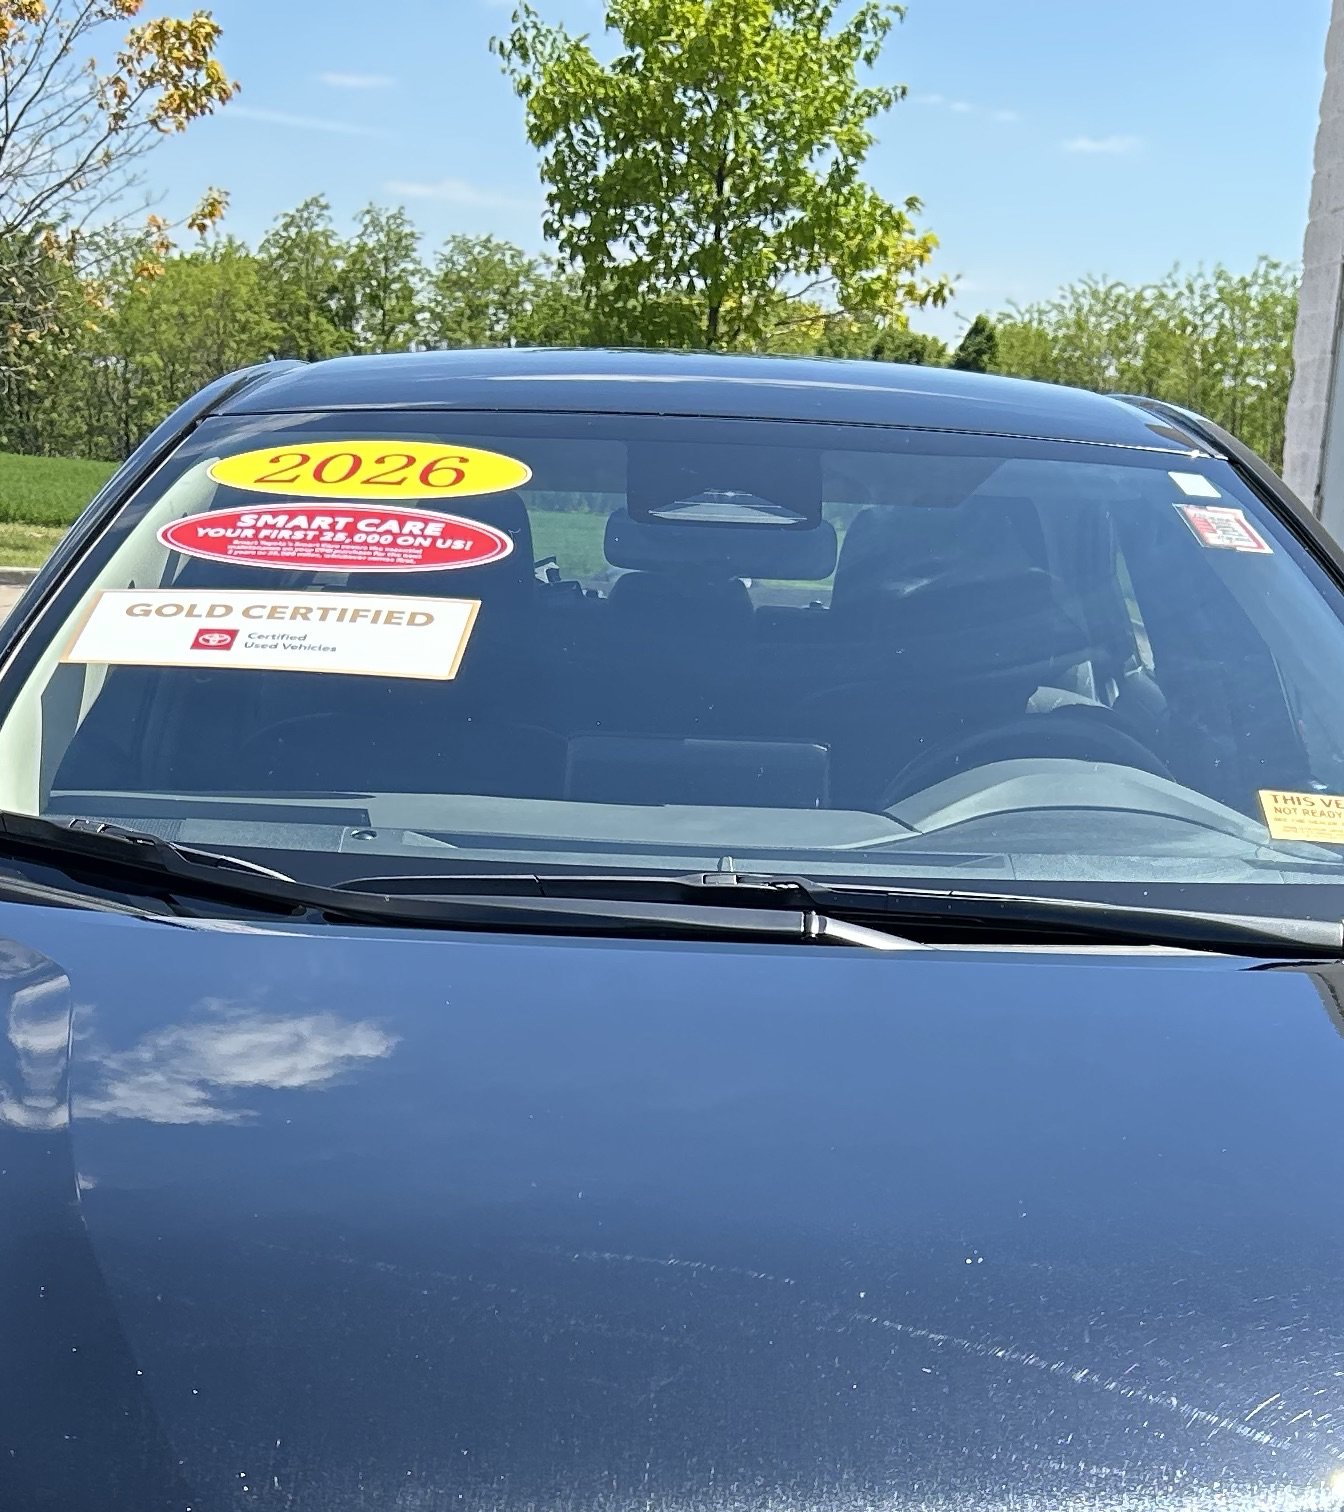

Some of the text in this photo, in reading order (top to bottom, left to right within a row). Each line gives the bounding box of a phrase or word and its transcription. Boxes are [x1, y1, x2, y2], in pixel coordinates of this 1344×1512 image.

[253, 453, 469, 487] 2026
[237, 514, 446, 536] SMART CARE
[196, 527, 256, 539] YOUR
[258, 528, 320, 541] FIRST
[396, 536, 433, 548] ON
[435, 538, 474, 551] US!
[125, 603, 435, 627] GOLD CERTIFIED
[247, 632, 308, 642] Certified
[244, 641, 337, 652] Used Vehicles
[1271, 794, 1316, 806] THIS
[1273, 806, 1298, 815] NOT
[1302, 808, 1343, 819] READY
